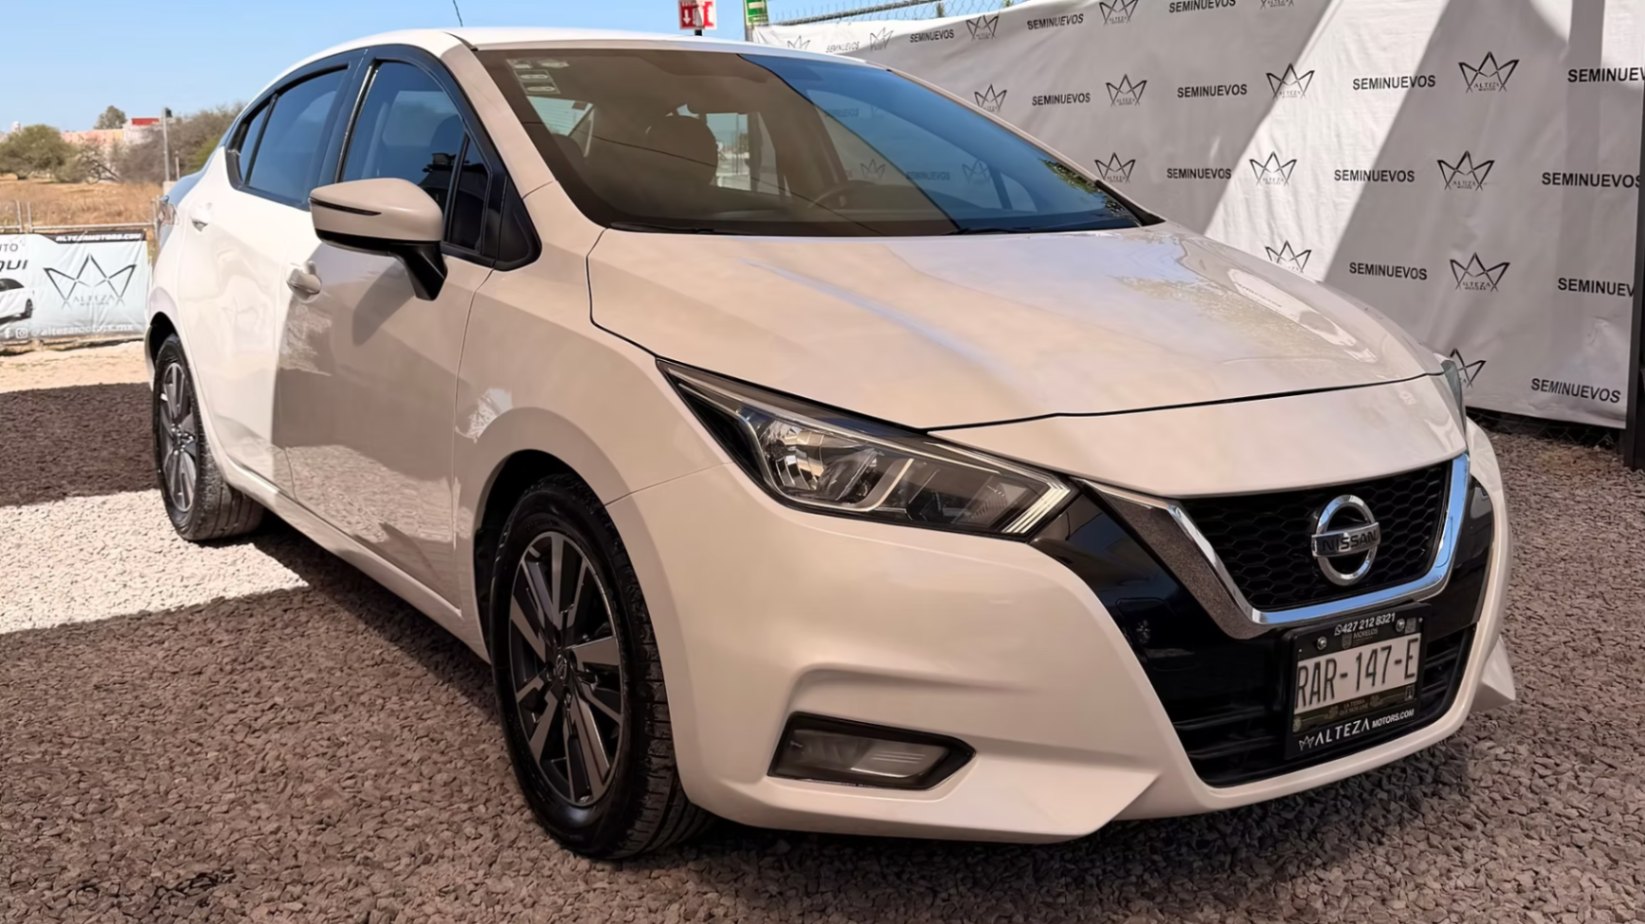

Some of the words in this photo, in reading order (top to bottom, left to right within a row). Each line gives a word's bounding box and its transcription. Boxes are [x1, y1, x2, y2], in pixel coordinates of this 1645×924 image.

[1027, 13, 1084, 30] SEMINUEVOS
[909, 29, 955, 43] SEMINUEVOS
[1353, 75, 1436, 90] SEMINUEVOS
[1031, 92, 1091, 106] SEMINUEVOS
[1177, 84, 1247, 98] SEMINUEVOS
[1166, 168, 1232, 180] SEMINUEVOS
[1334, 169, 1415, 182] SEMINUEVOS
[1349, 262, 1428, 281] SEMINUEVOS
[1530, 378, 1621, 404] SEMINUEVOS
[1322, 530, 1377, 552] NISSAN
[1341, 621, 1358, 633] 427
[1359, 617, 1375, 629] 212
[1295, 638, 1419, 709] RAR-147-E
[1314, 718, 1370, 746] ALTEZA
[1371, 708, 1415, 729] MOTORS.COM
